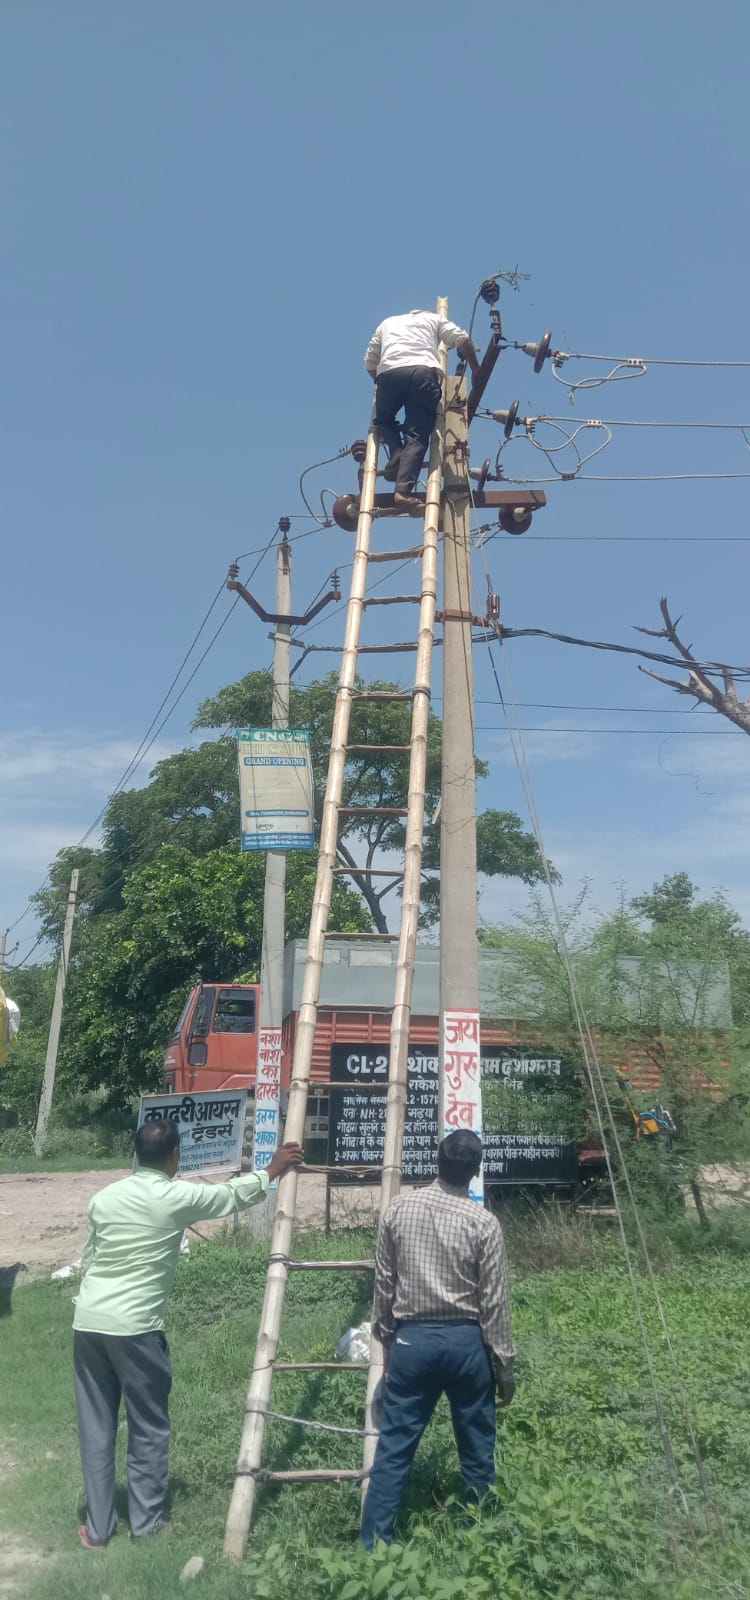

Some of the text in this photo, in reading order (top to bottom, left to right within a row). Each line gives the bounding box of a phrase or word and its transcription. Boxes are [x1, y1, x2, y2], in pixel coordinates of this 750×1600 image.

[254, 731, 293, 742] CNG
[272, 758, 304, 766] OPENING
[445, 1018, 480, 1045] जय
[346, 1053, 388, 1074] CL-2
[261, 1065, 280, 1079] का
